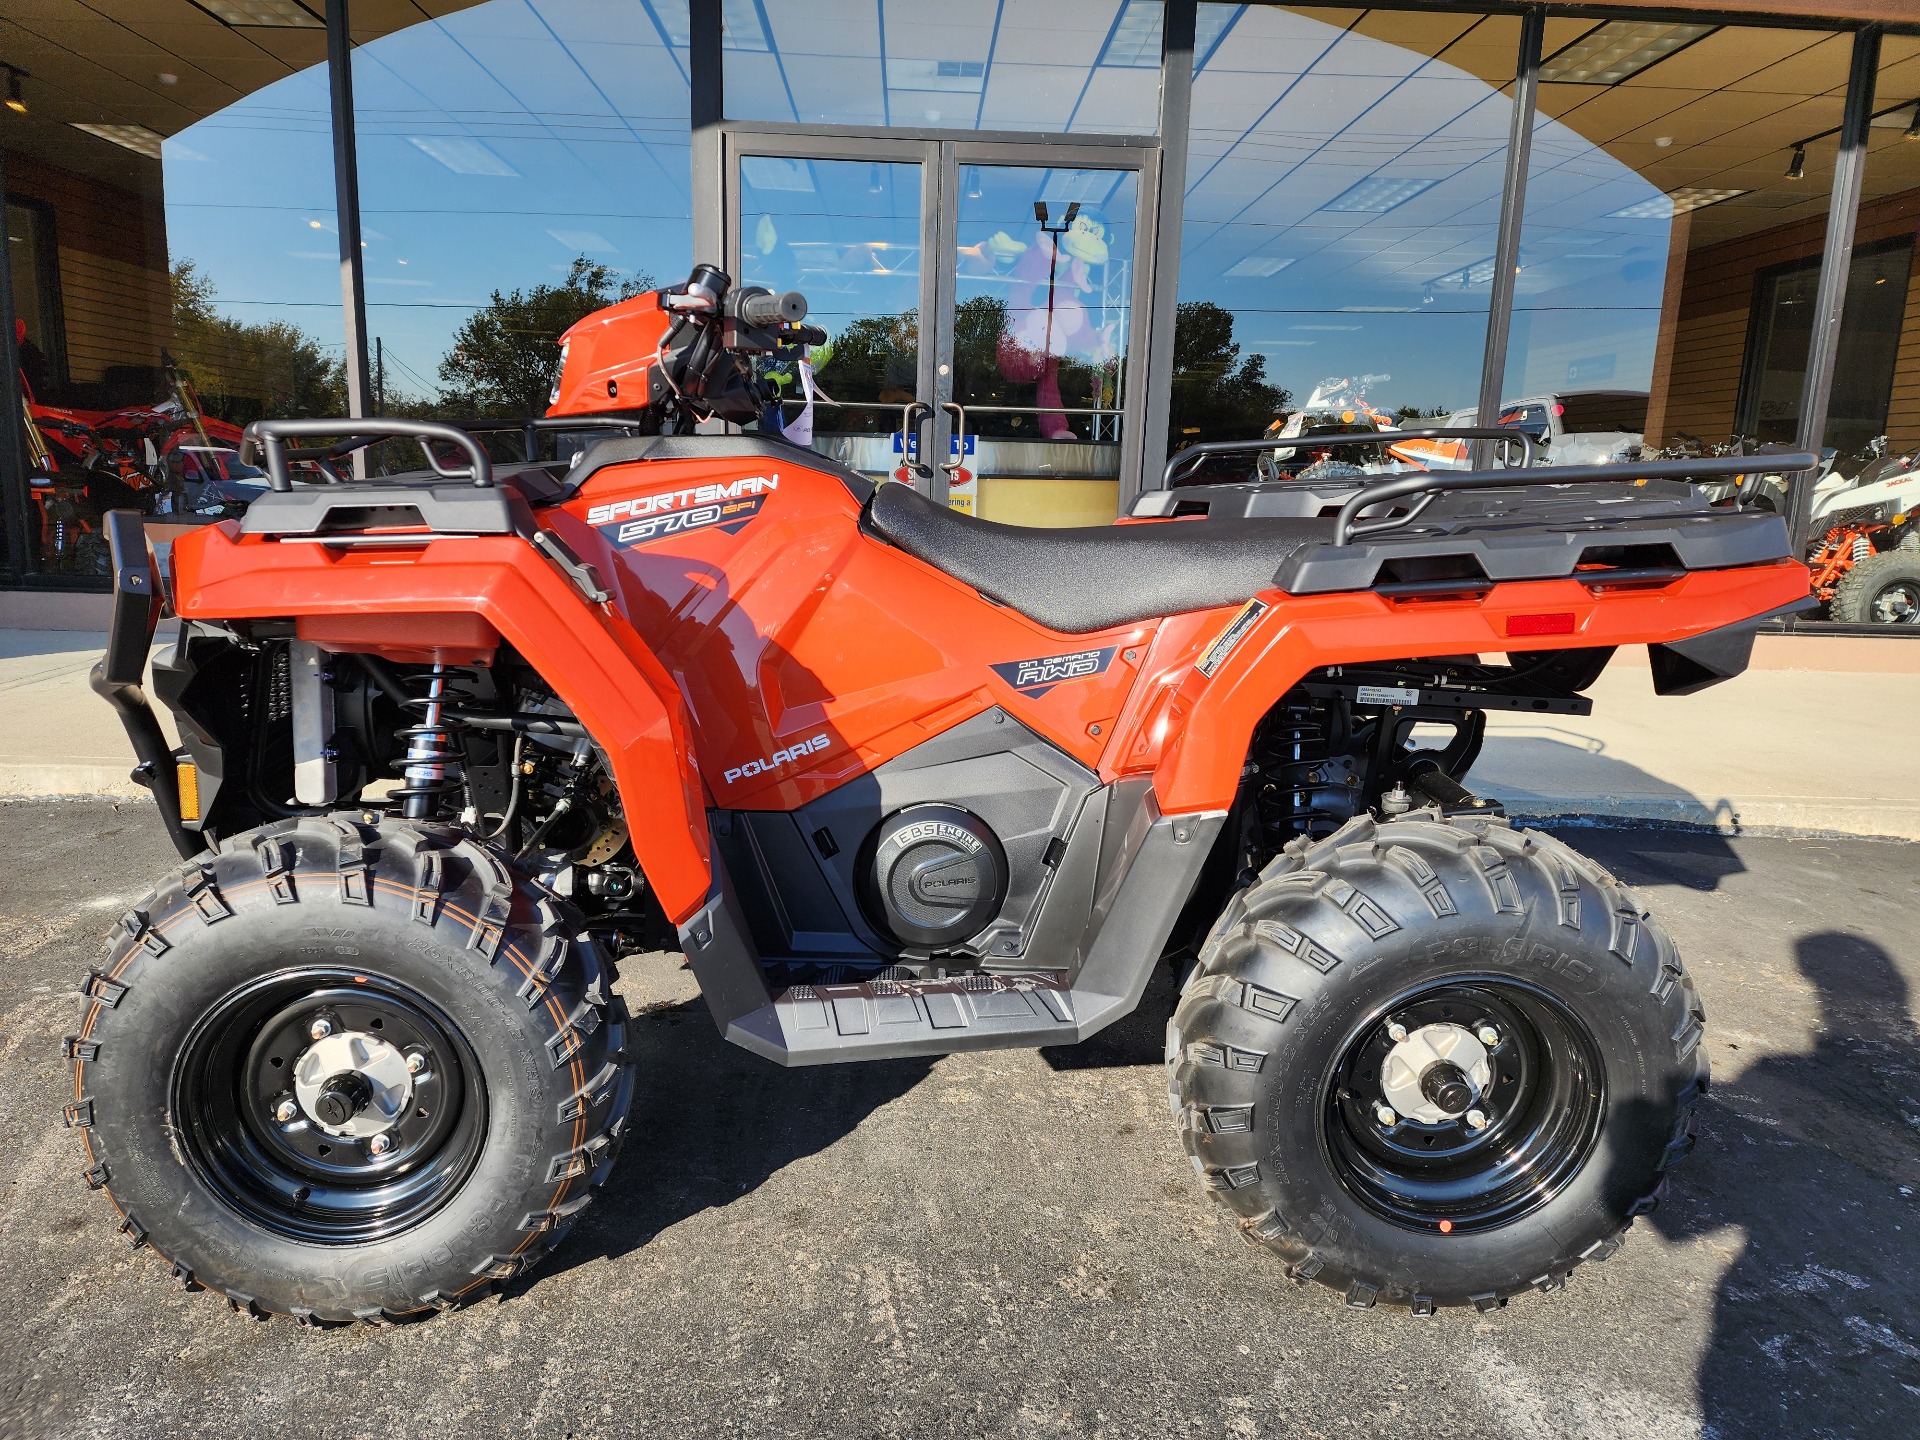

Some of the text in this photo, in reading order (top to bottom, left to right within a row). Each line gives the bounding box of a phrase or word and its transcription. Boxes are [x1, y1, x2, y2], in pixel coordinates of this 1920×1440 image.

[1885, 477, 1913, 487] JACKAL
[586, 472, 780, 526] SPORTSMAN
[617, 503, 722, 543] 570
[1016, 658, 1100, 685] AWD
[1018, 650, 1101, 669] ON DEMAND
[723, 733, 831, 785] POLARIS
[899, 824, 980, 851] EBS ENGINE
[924, 876, 976, 889] POLARIS
[1425, 935, 1594, 983] POLARIS
